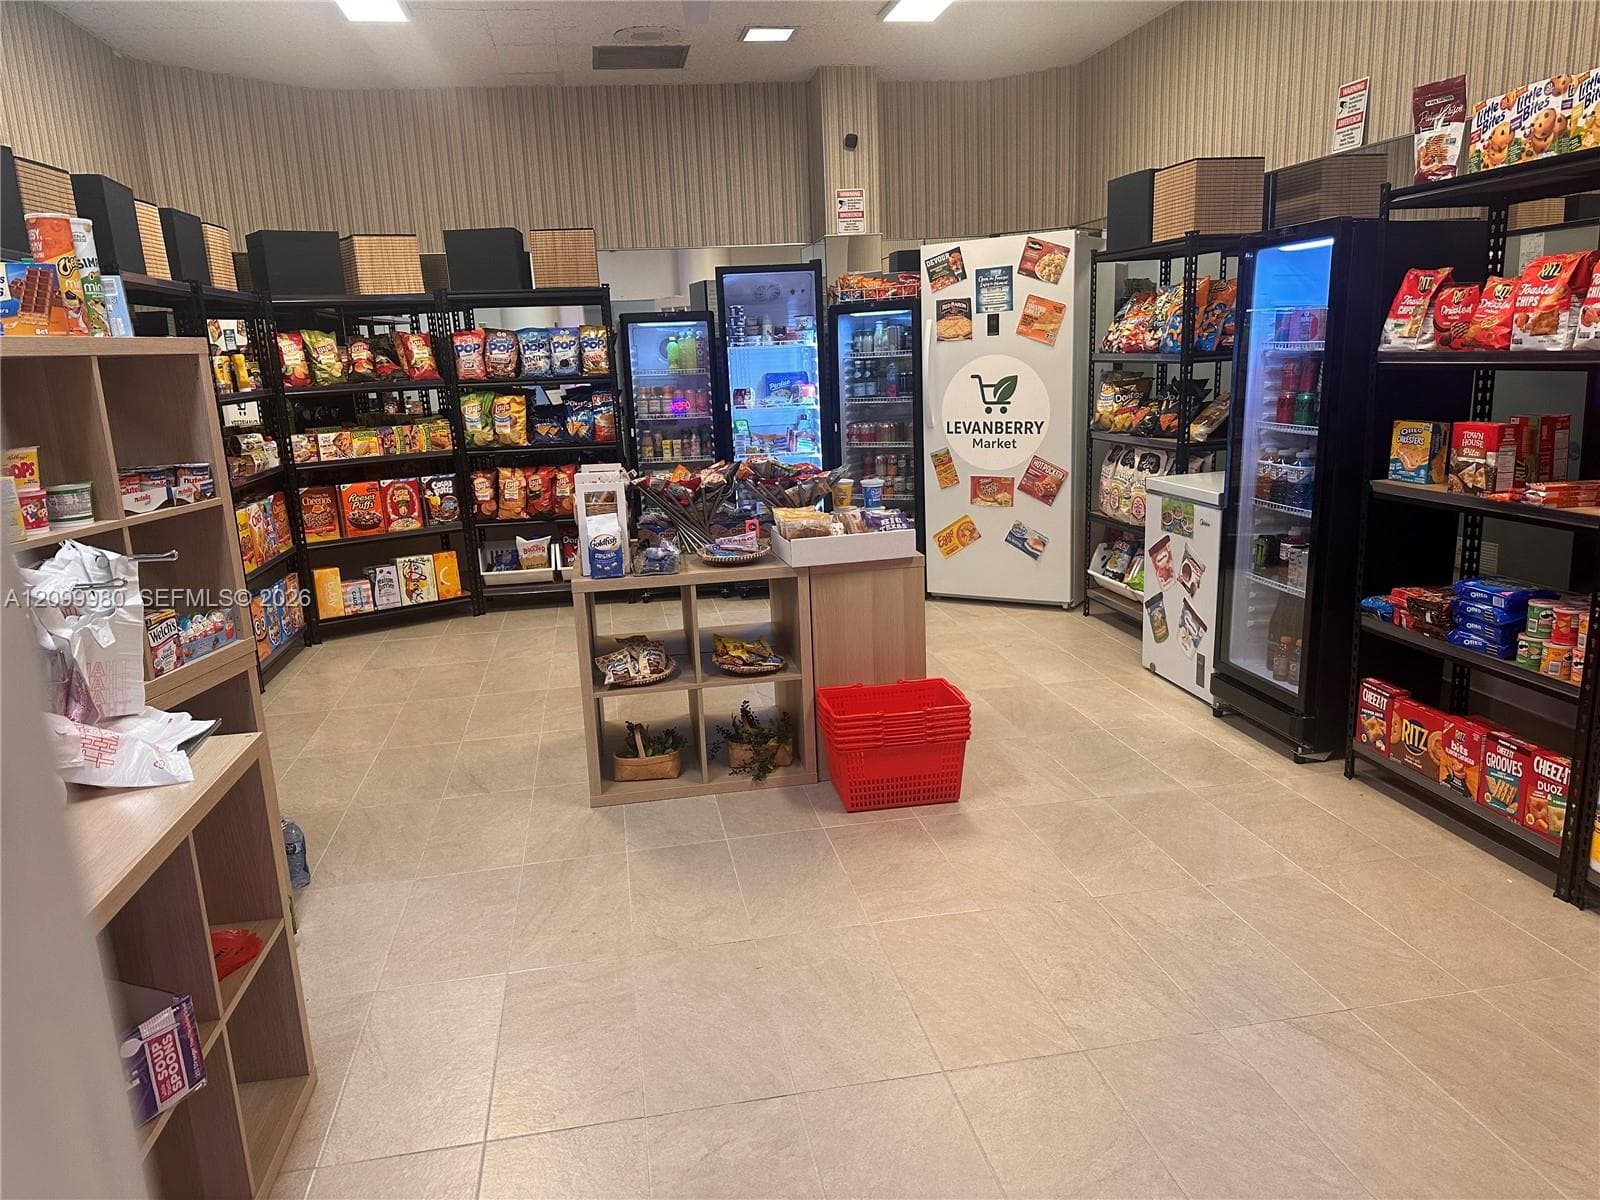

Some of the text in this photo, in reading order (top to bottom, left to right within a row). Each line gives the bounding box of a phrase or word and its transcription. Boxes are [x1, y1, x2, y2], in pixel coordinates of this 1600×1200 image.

[1517, 86, 1543, 114] Little
[1477, 101, 1499, 128] Little
[1523, 97, 1550, 122] Bites
[1482, 112, 1506, 135] Bites
[1540, 261, 1562, 277] RITZ
[1516, 296, 1540, 307] CHIPS
[454, 343, 480, 358] POP
[489, 343, 515, 355] POP
[523, 342, 545, 353] POP
[552, 340, 577, 353] POP
[580, 339, 605, 352] POP
[946, 421, 1044, 435] LEVANBERRY
[1463, 430, 1485, 440] TOWN
[972, 438, 1017, 449] Market
[1462, 438, 1484, 449] HOUSE
[431, 480, 453, 489] Cocoa
[352, 500, 375, 510] Puffs
[590, 535, 618, 549] Goldfish
[149, 620, 177, 644] Welch's
[1402, 718, 1429, 752] RITZ
[1451, 740, 1468, 756] bits
[1486, 751, 1523, 778] GROOVES
[1537, 780, 1563, 796] DUOZ
[151, 1043, 169, 1081] SOUP
[162, 1034, 183, 1092] SPOONS
